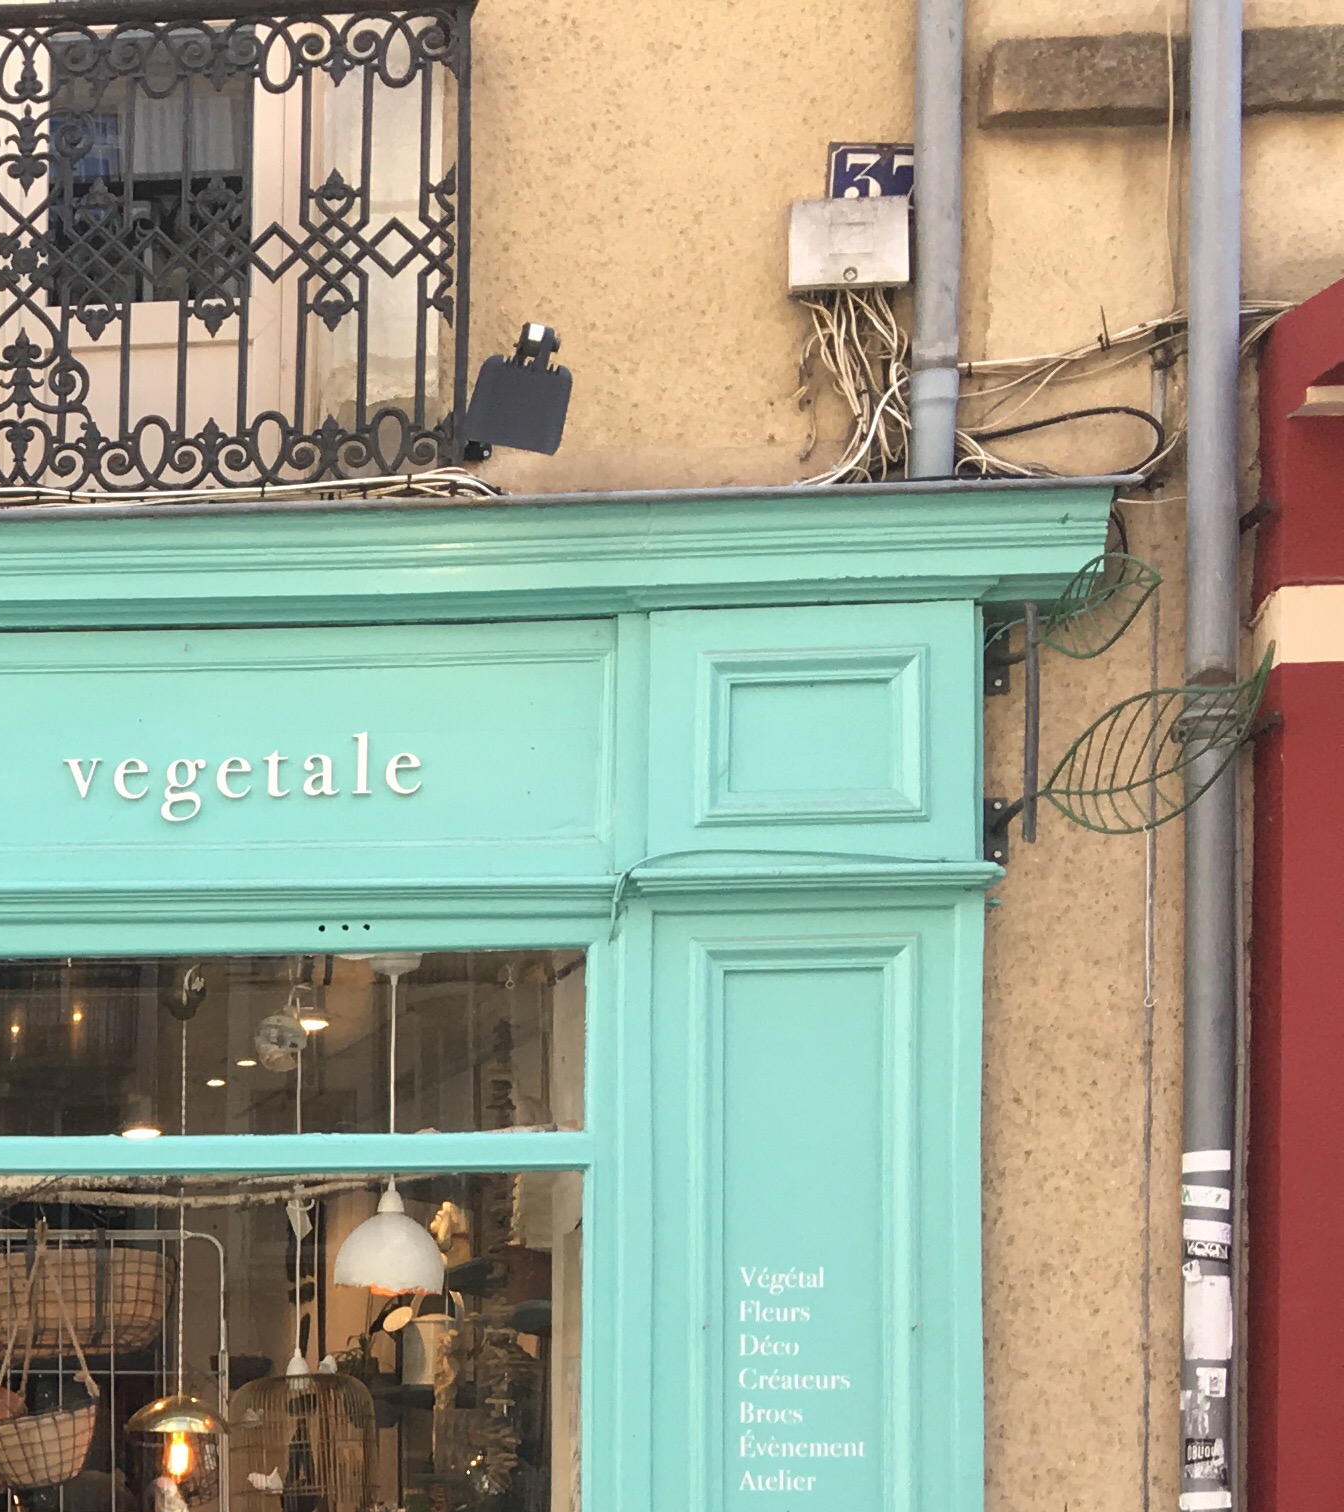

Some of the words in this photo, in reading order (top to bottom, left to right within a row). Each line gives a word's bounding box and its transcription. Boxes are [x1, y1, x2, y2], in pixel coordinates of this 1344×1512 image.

[62, 731, 424, 822] vegetale
[738, 1265, 825, 1295] Végétal
[739, 1300, 811, 1322] Fleurs
[739, 1333, 800, 1356] Déco
[738, 1367, 851, 1390] Créateurs
[739, 1401, 804, 1424] Brocs
[738, 1469, 817, 1491] Atelier
